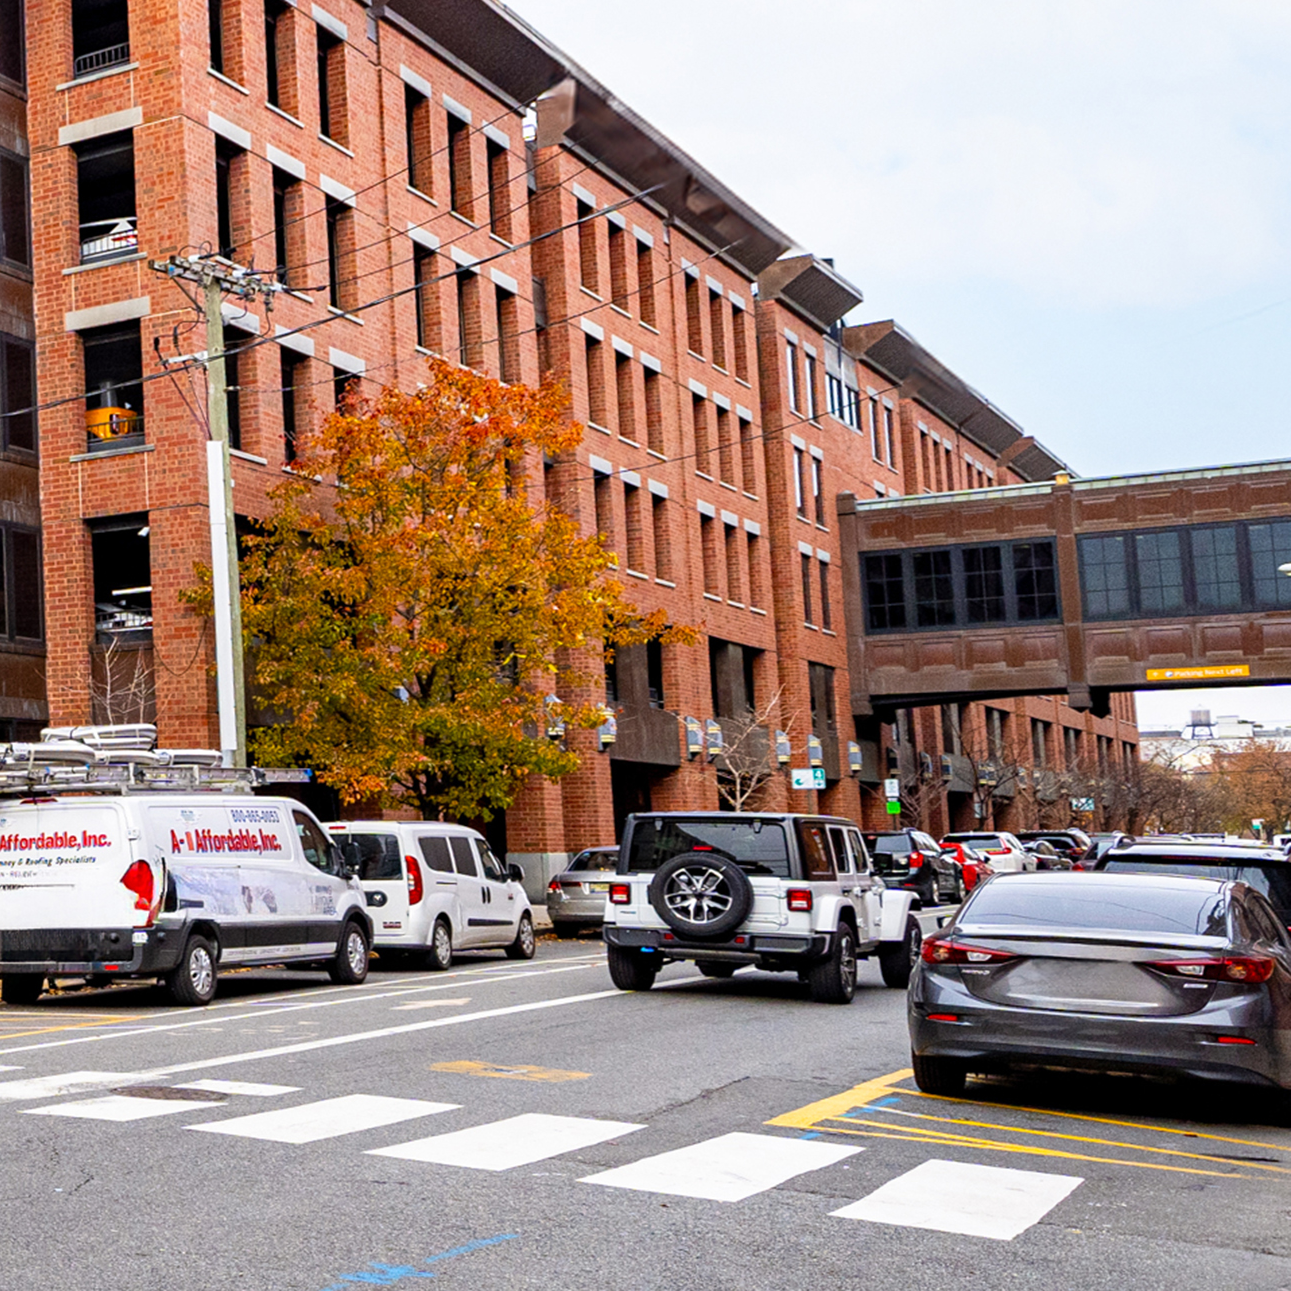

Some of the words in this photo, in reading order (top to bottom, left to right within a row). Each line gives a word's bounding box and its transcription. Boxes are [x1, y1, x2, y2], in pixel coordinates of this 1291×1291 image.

[17, 858, 23, 866] &
[25, 857, 53, 867] Roofing
[55, 856, 96, 866] Specialists
